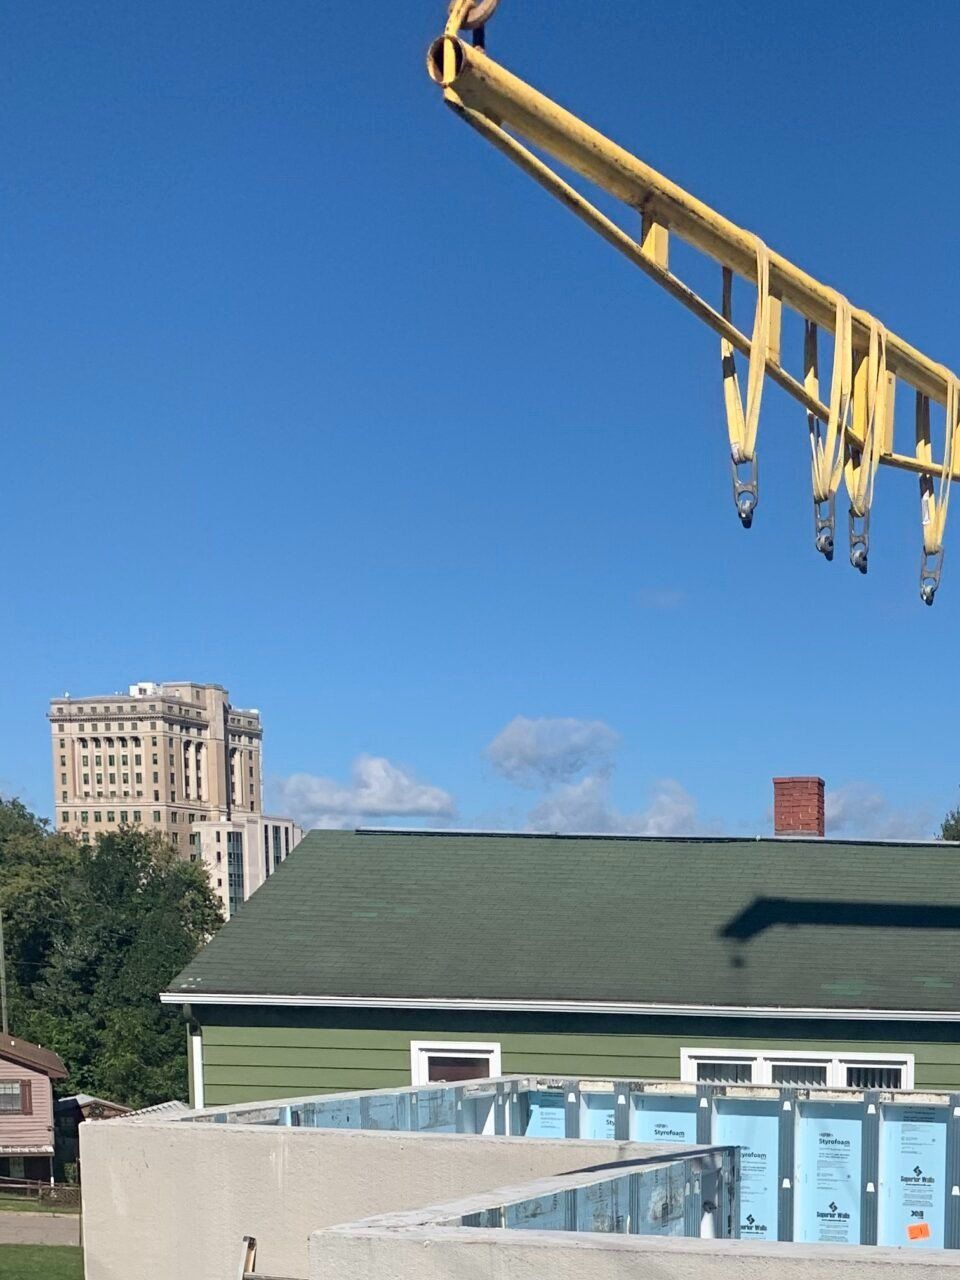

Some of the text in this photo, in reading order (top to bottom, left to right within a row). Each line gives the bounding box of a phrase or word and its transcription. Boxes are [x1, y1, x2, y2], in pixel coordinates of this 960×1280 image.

[654, 1129, 685, 1138] Styrofoam
[818, 1138, 851, 1146] Styrofoam
[740, 1152, 767, 1160] yrofoam
